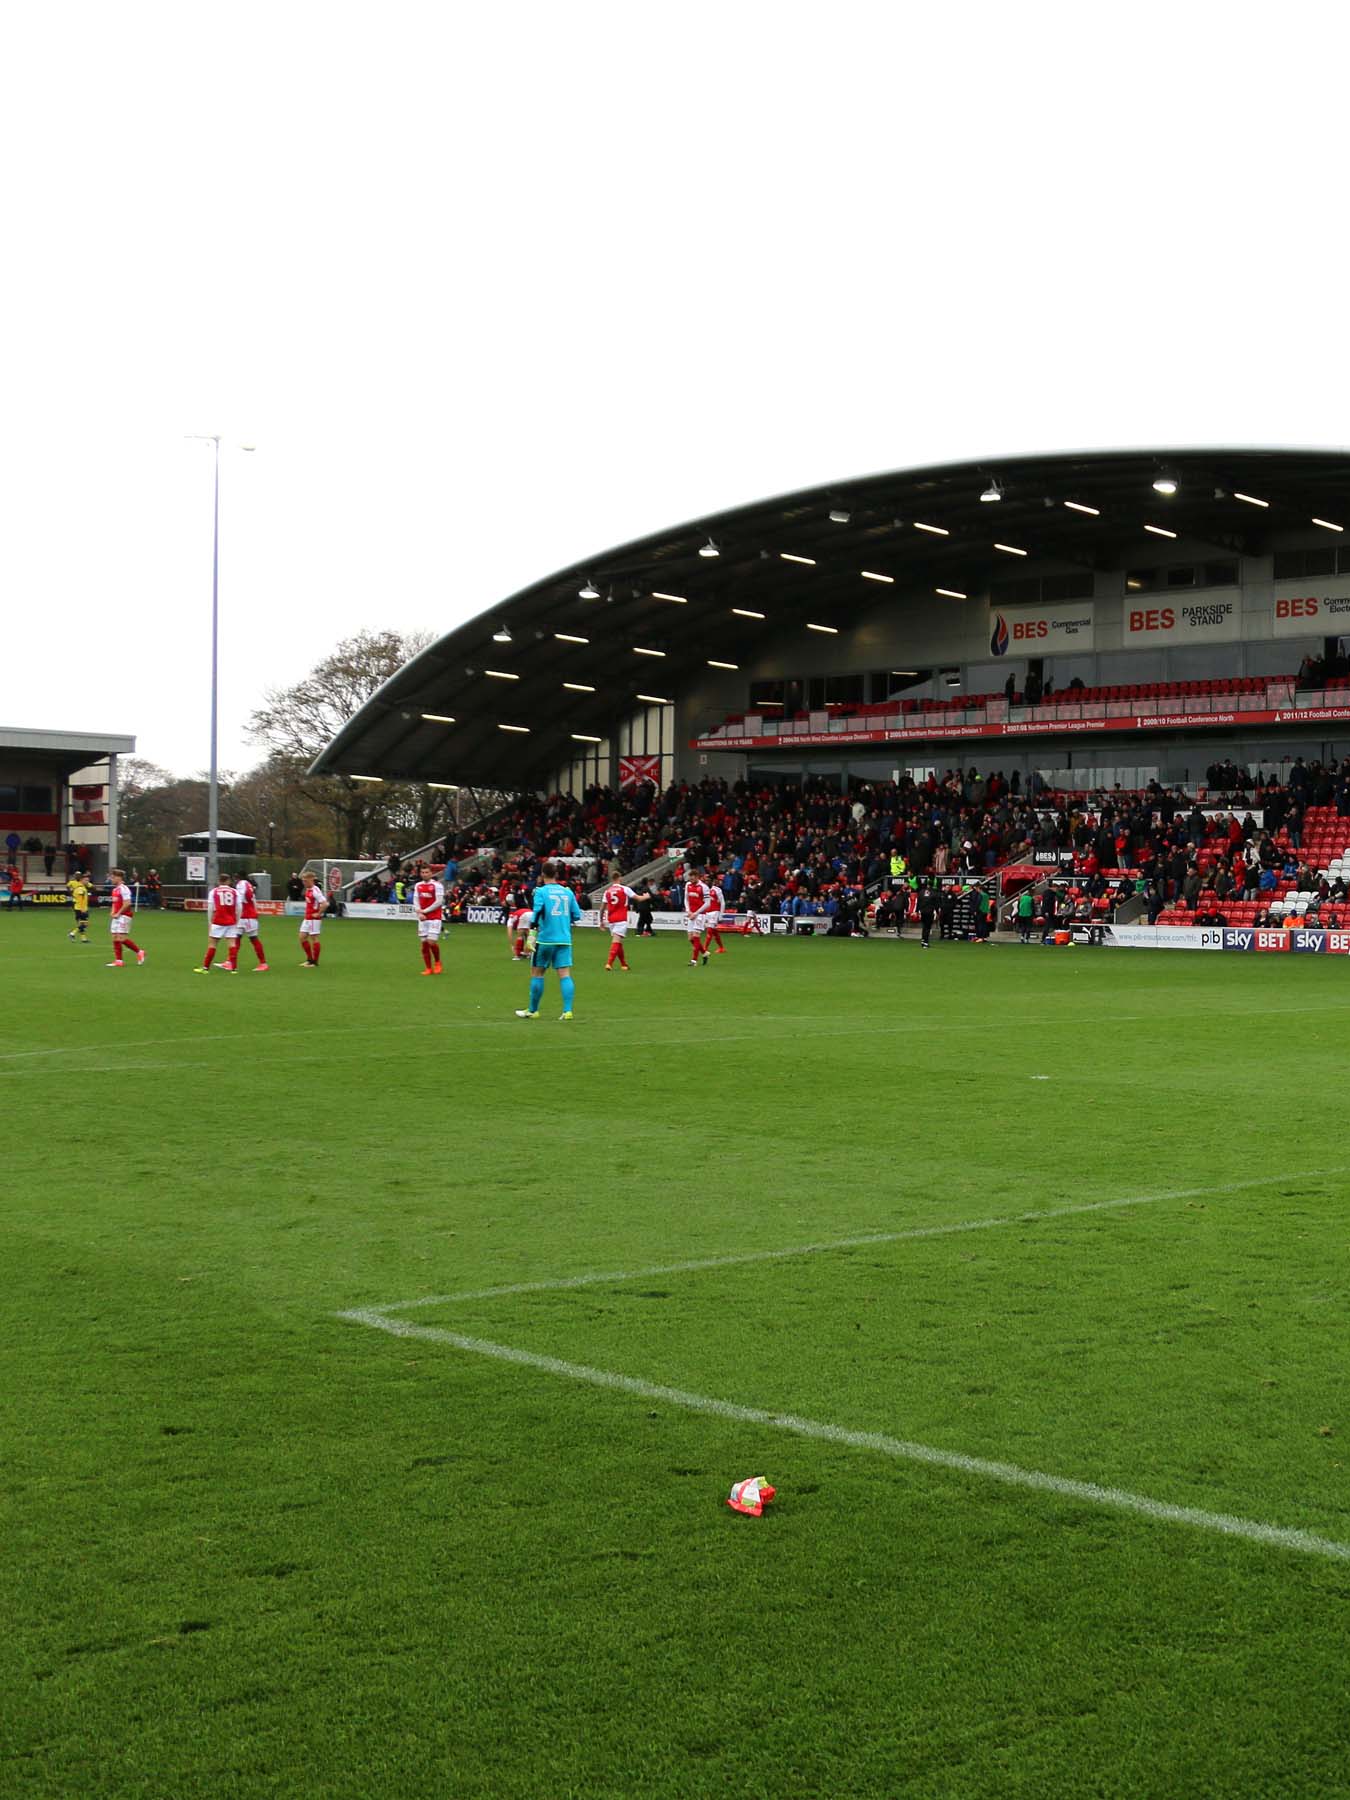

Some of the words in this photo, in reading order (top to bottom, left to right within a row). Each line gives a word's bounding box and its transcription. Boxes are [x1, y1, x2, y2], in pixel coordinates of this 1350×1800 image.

[1182, 604, 1233, 617] PARKSIDE
[1275, 597, 1318, 618] BES
[1051, 618, 1091, 629] Commercial
[1130, 608, 1175, 632] BES
[1190, 614, 1223, 627] STAND
[1013, 620, 1049, 640] BES
[1166, 716, 1187, 725] Football
[1188, 715, 1217, 724] Conference
[1218, 714, 1234, 722] North
[1283, 711, 1308, 719] 2011/12
[1309, 710, 1332, 718] Football
[216, 891, 234, 906] 18
[549, 895, 569, 916] 21
[610, 892, 619, 905] 5
[1202, 930, 1220, 947] pib
[1226, 931, 1252, 950] sky
[1258, 933, 1286, 948] BET
[1296, 931, 1324, 951] sky
